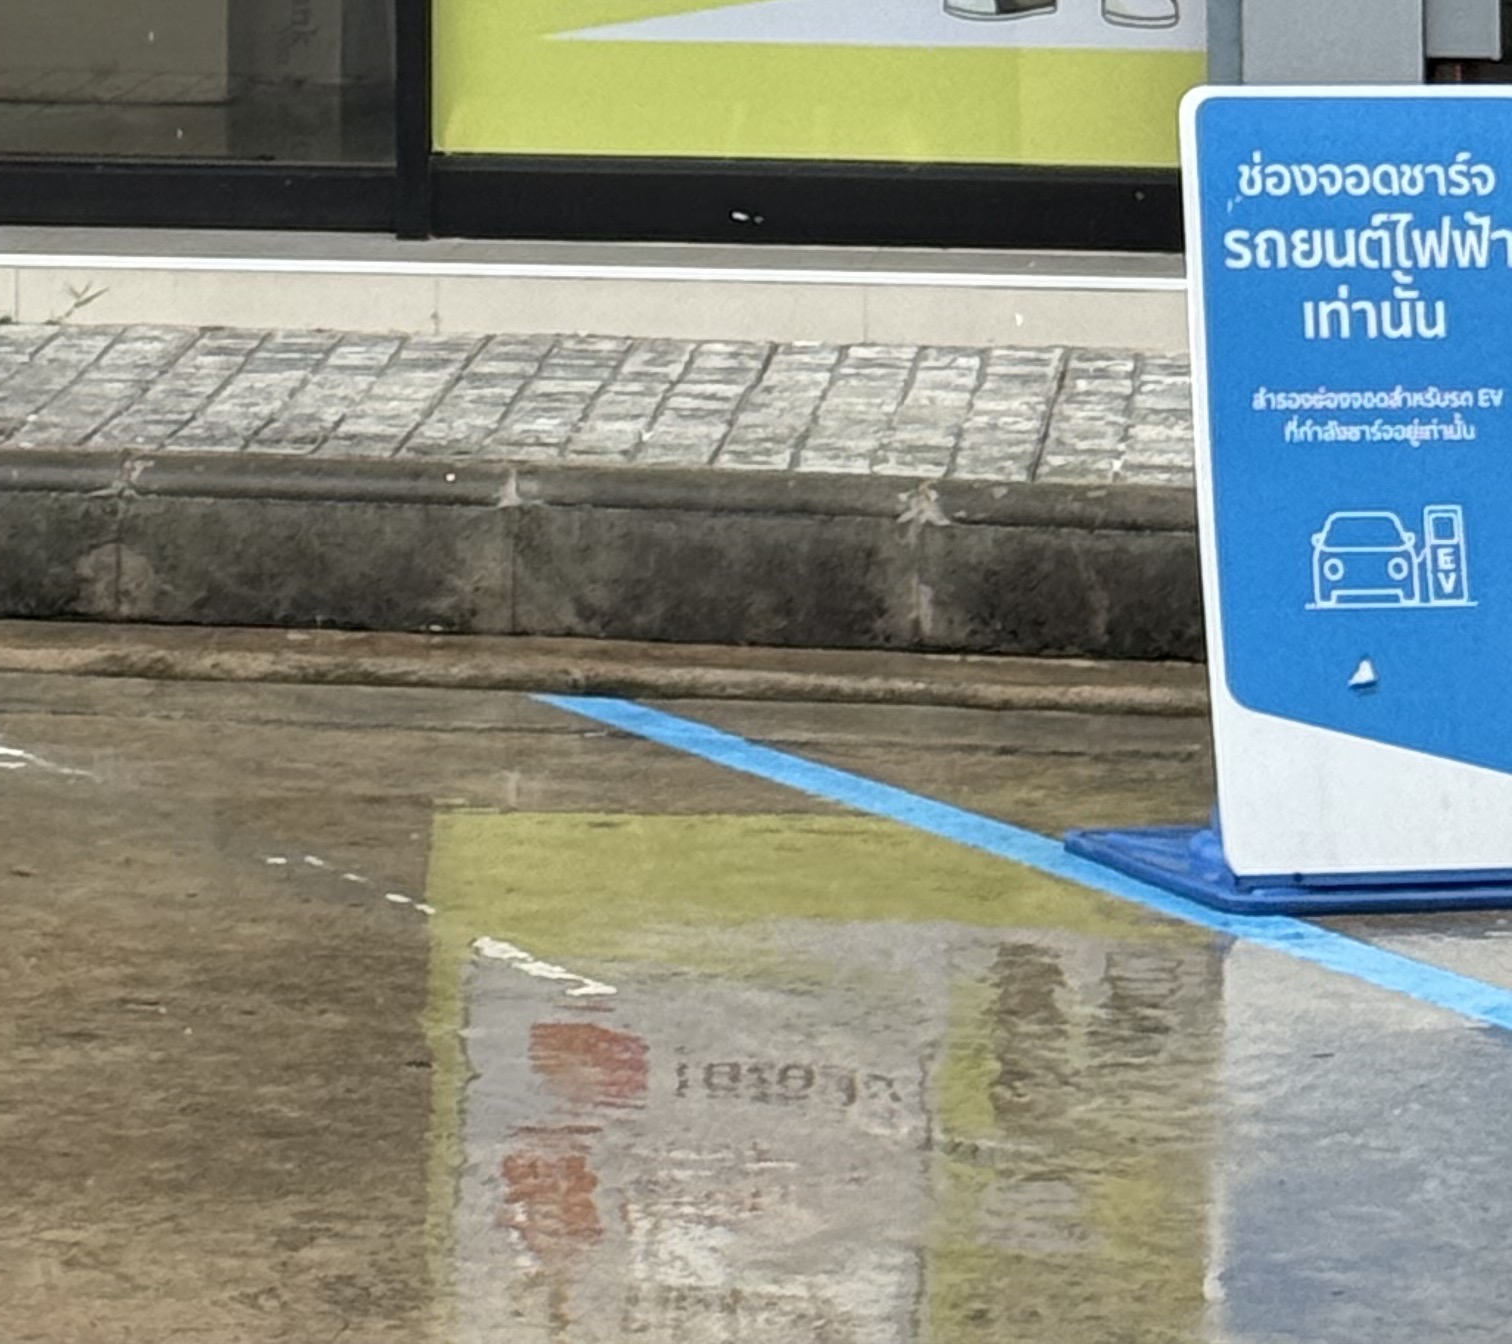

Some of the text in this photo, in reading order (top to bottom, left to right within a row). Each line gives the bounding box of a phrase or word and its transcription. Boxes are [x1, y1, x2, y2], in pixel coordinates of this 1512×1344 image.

[1237, 150, 1496, 197] ช่องจอดชาร์จ
[1223, 210, 1512, 270] รถยนต์ไฟฟ้า
[1302, 269, 1447, 339] เท่านั้น
[1477, 388, 1504, 408] EV
